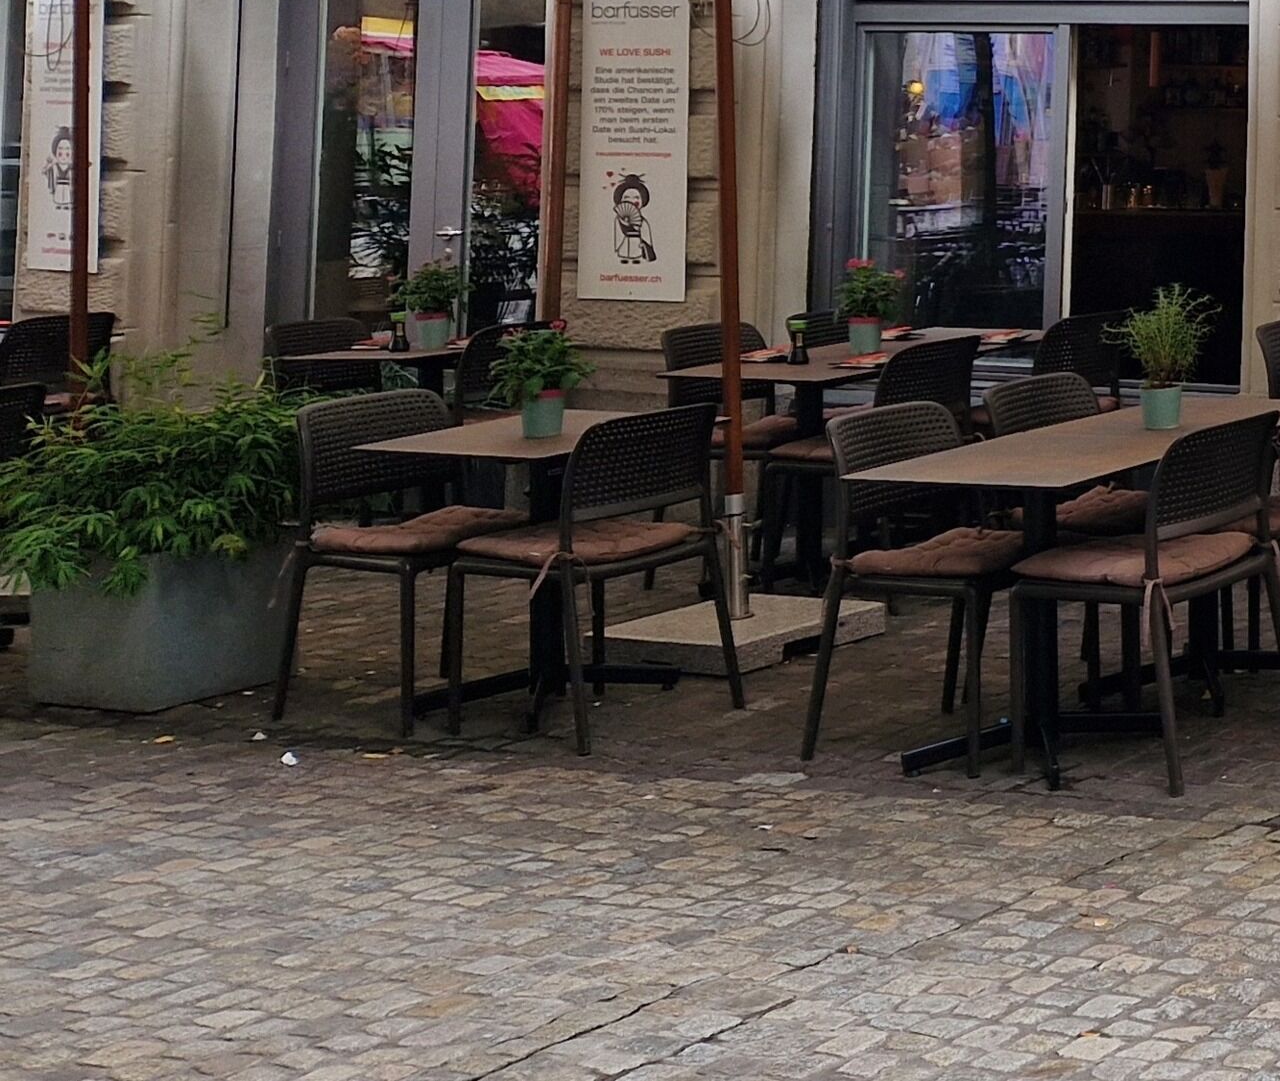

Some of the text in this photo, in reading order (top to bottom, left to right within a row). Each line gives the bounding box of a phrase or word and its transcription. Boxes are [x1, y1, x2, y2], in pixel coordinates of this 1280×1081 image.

[599, 48, 672, 56] WE LOVE SUSHI
[600, 273, 662, 283] barfuesser.ch
